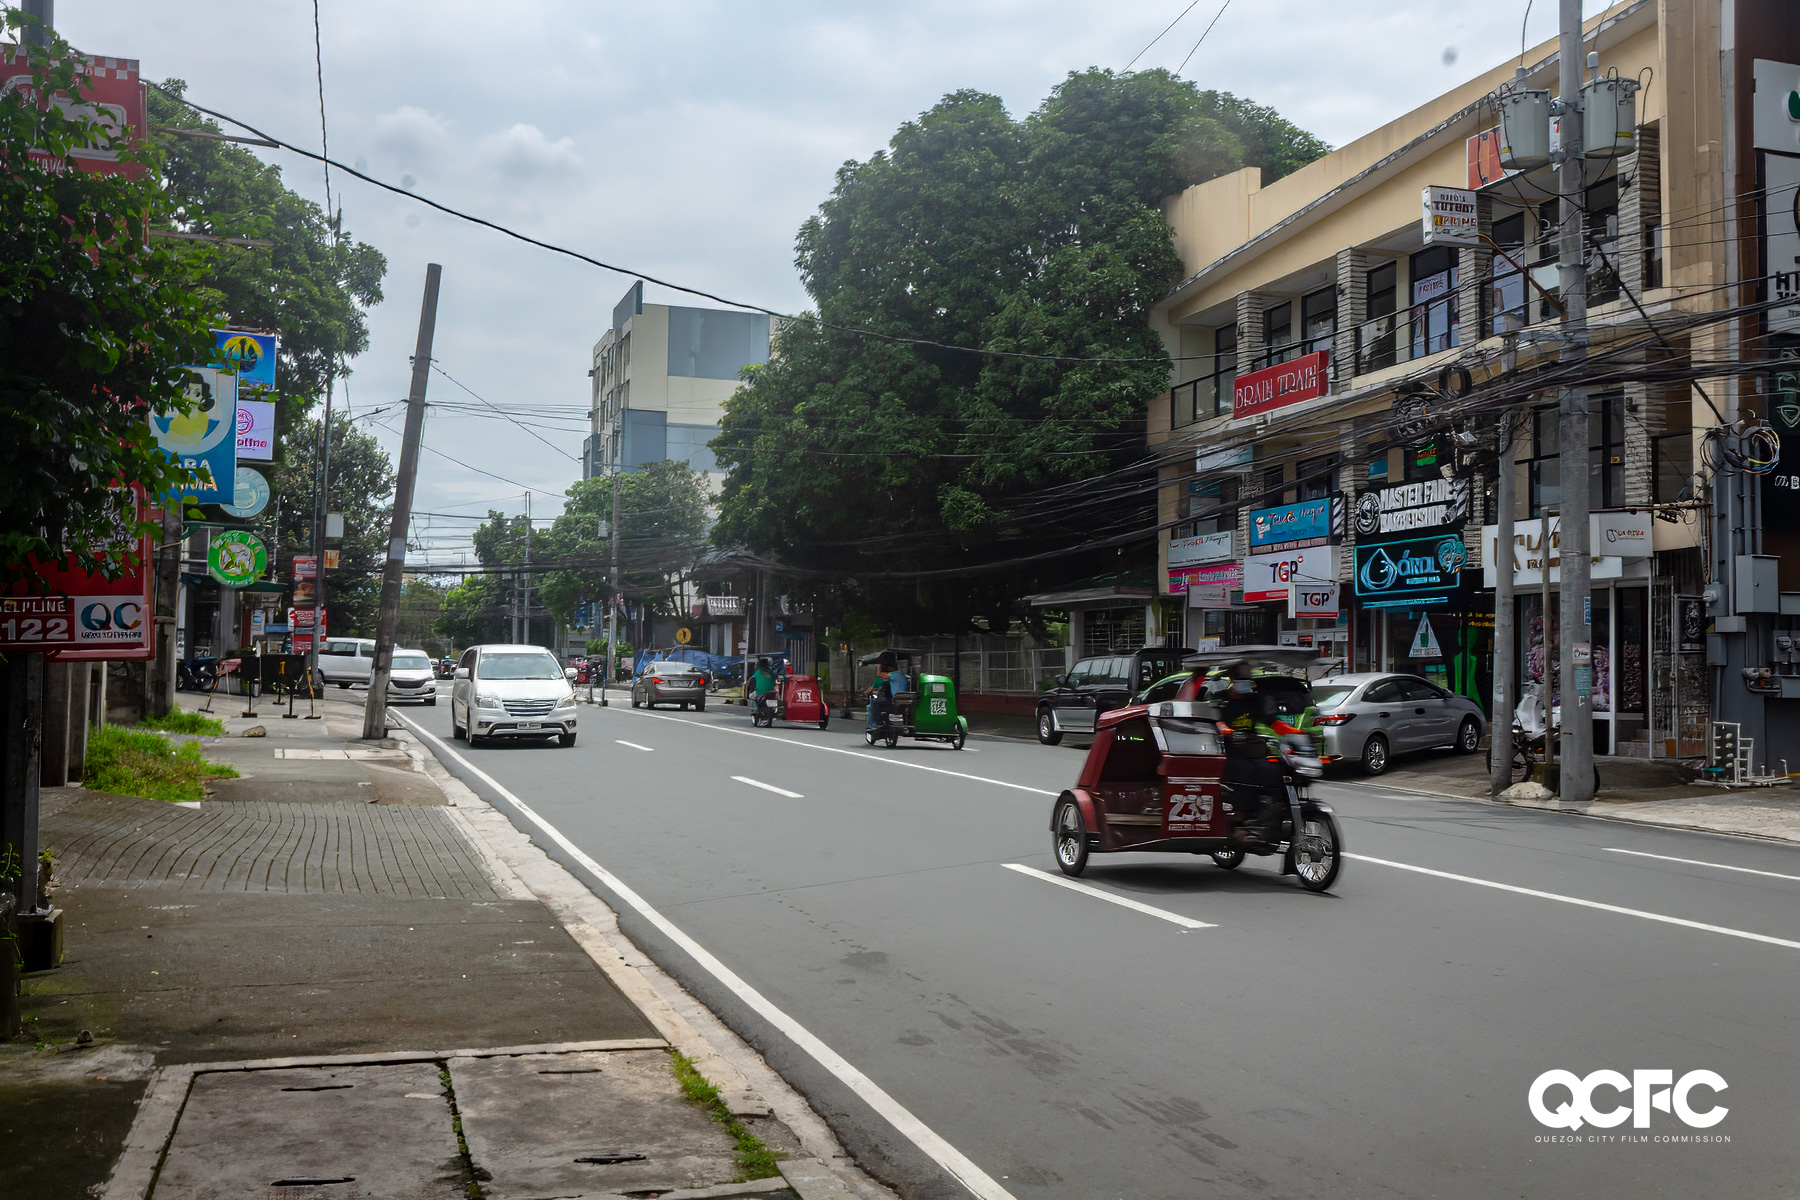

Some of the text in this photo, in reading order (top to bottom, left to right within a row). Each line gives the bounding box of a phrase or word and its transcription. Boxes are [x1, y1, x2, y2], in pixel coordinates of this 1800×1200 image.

[1270, 560, 1299, 583] TGP
[0, 600, 66, 613] ELPLINE
[1301, 592, 1330, 607] TGP
[80, 602, 142, 631] QC
